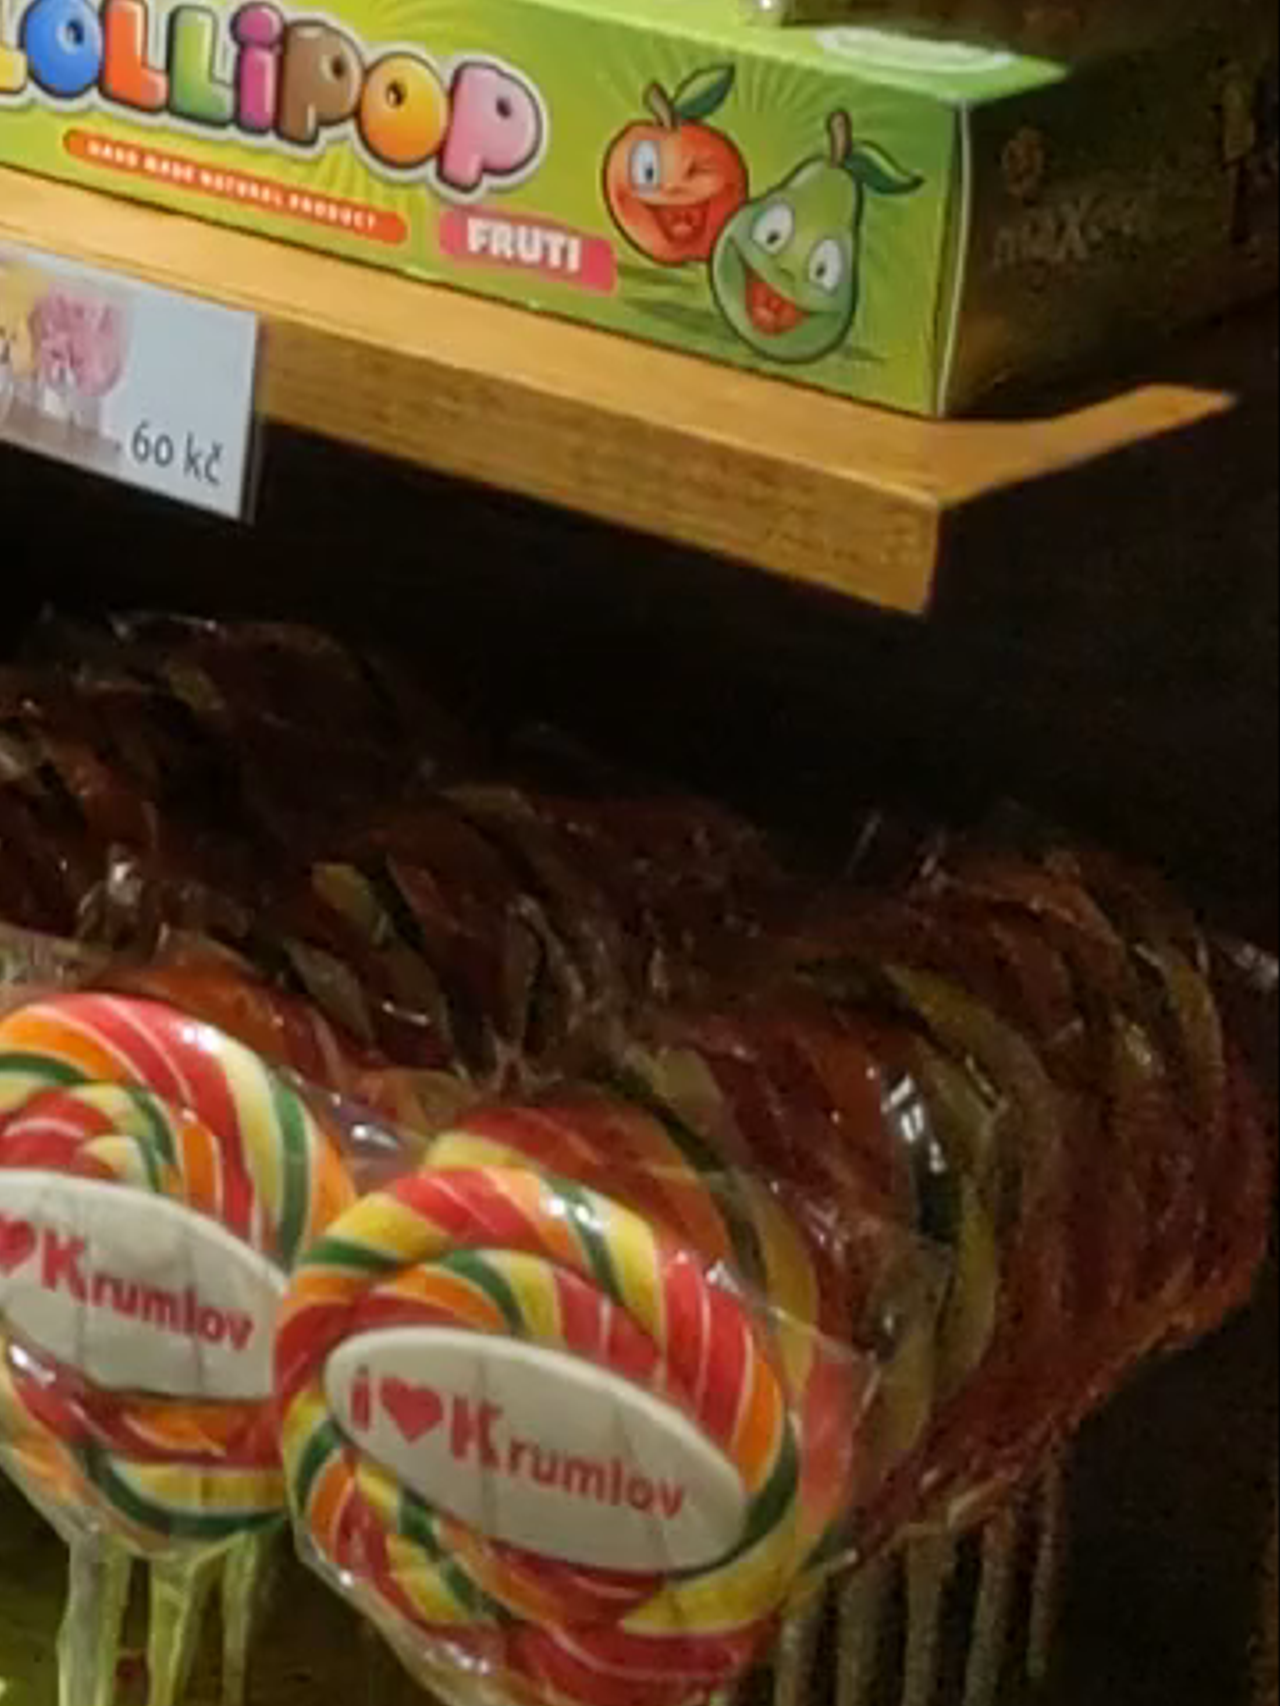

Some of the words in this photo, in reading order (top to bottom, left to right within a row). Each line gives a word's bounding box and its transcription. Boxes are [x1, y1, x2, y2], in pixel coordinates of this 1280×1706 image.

[467, 217, 581, 273] FRUTI
[131, 419, 175, 468] 60
[183, 430, 224, 487] kč
[39, 1231, 254, 1354] Krumlov
[449, 1392, 686, 1522] Krumlov
